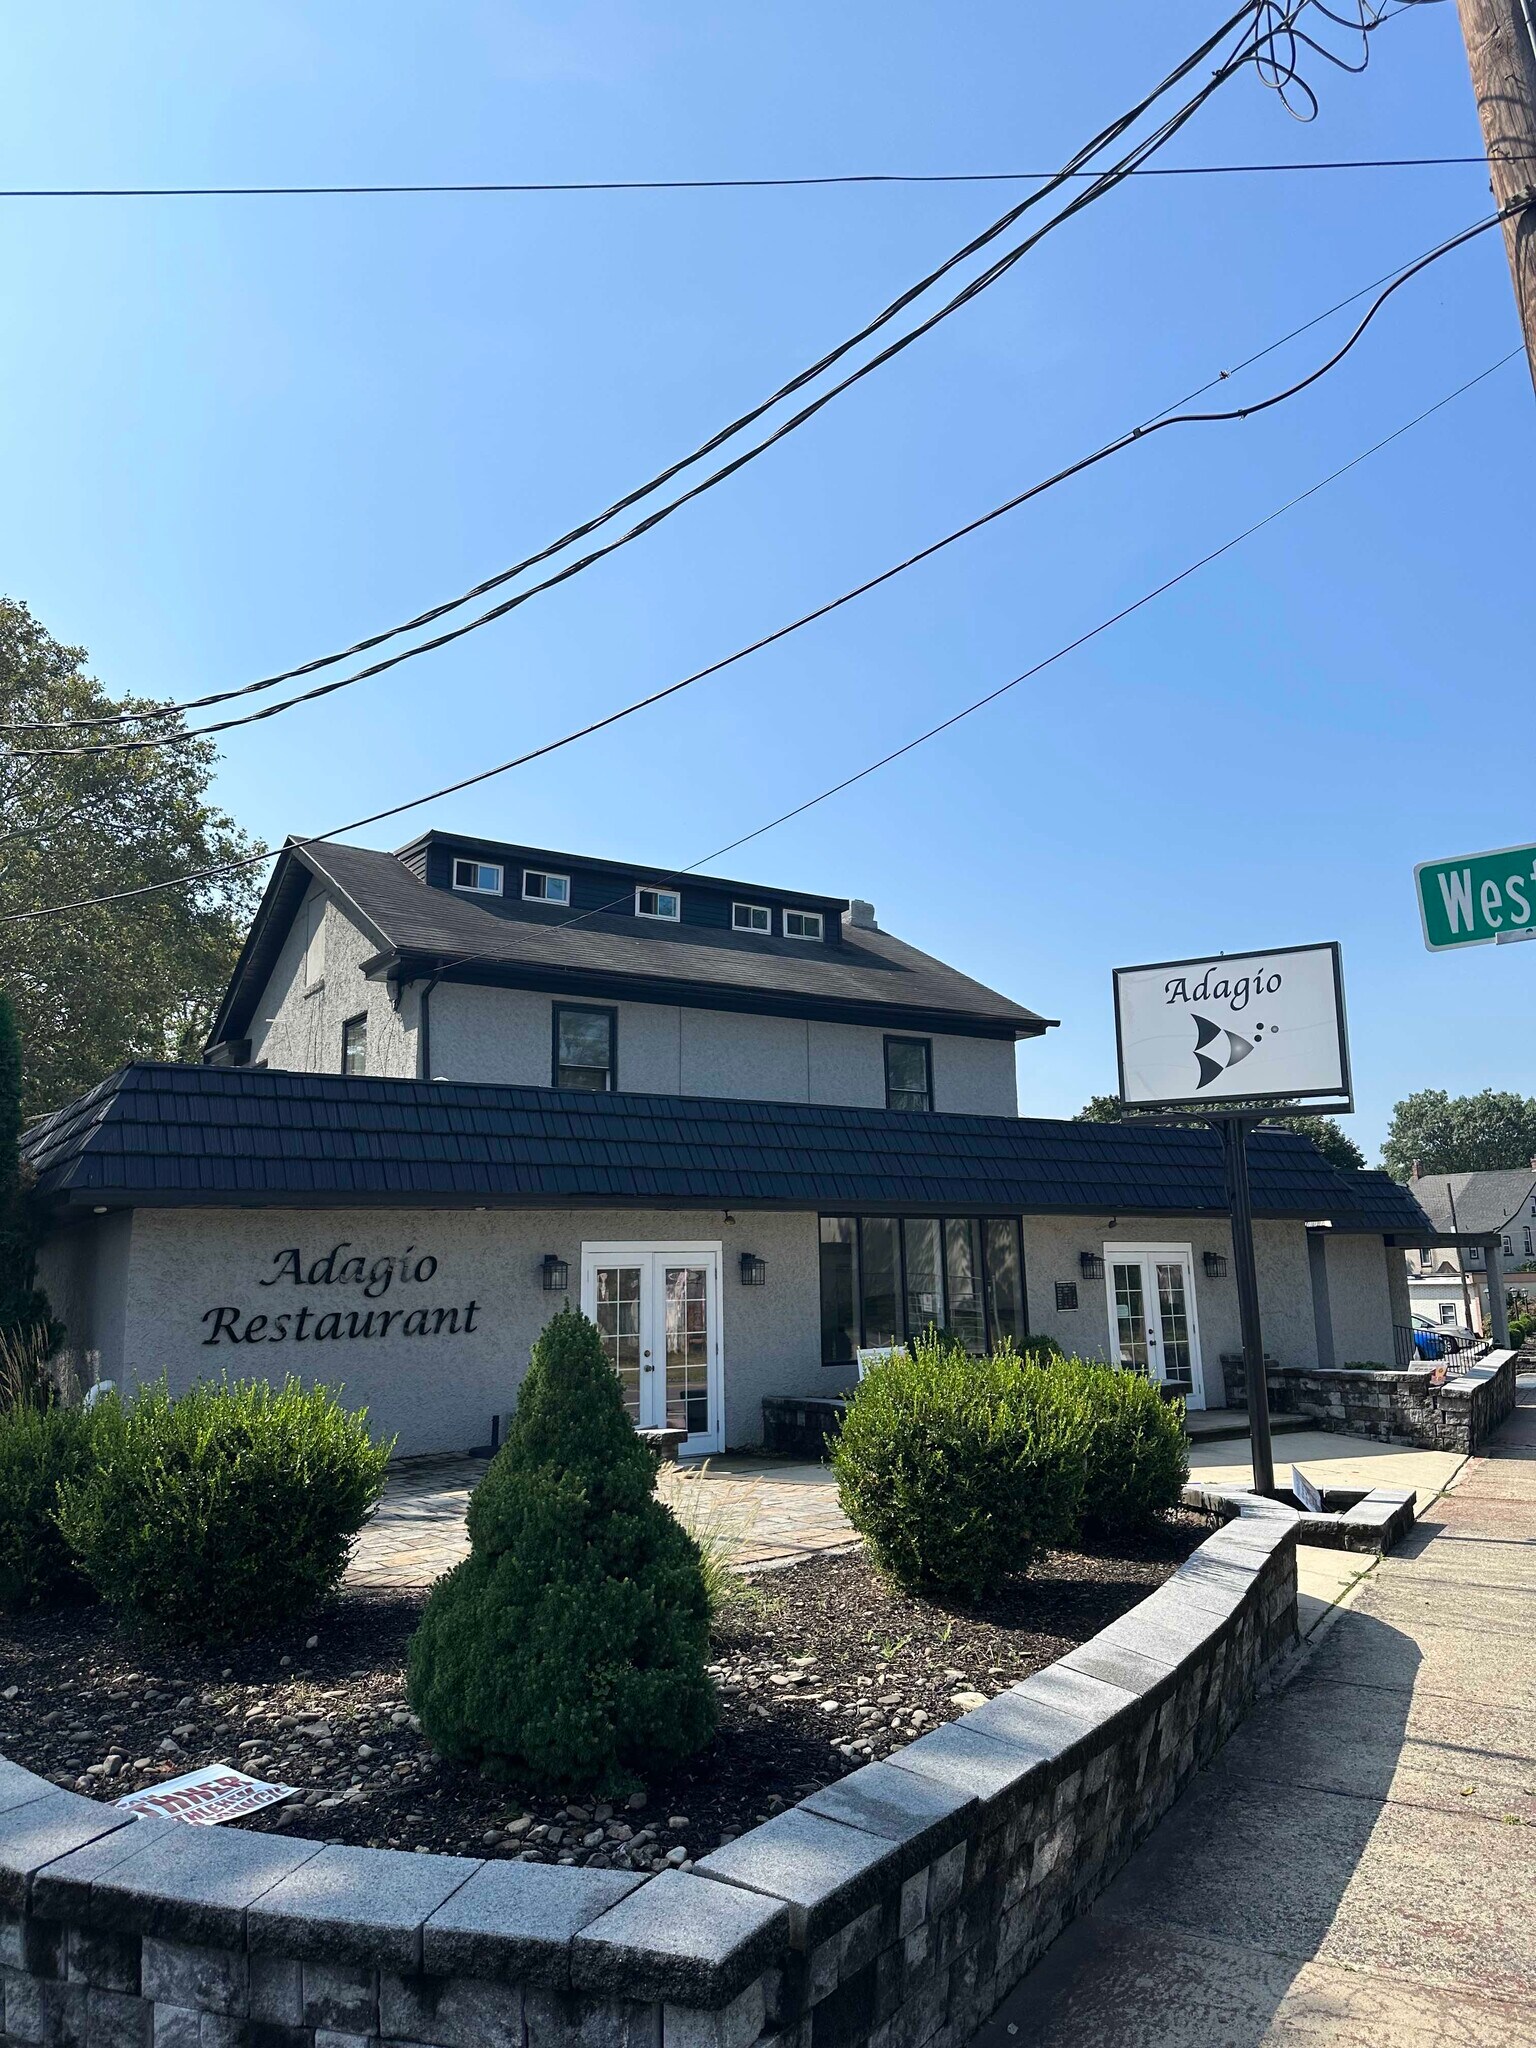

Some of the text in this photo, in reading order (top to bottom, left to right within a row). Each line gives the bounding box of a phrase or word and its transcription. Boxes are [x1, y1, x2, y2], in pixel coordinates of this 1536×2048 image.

[1437, 859, 1536, 934] Wes
[1164, 966, 1282, 1012] Adagio
[258, 1242, 439, 1299] Adagio
[201, 1299, 482, 1346] Restaurant
